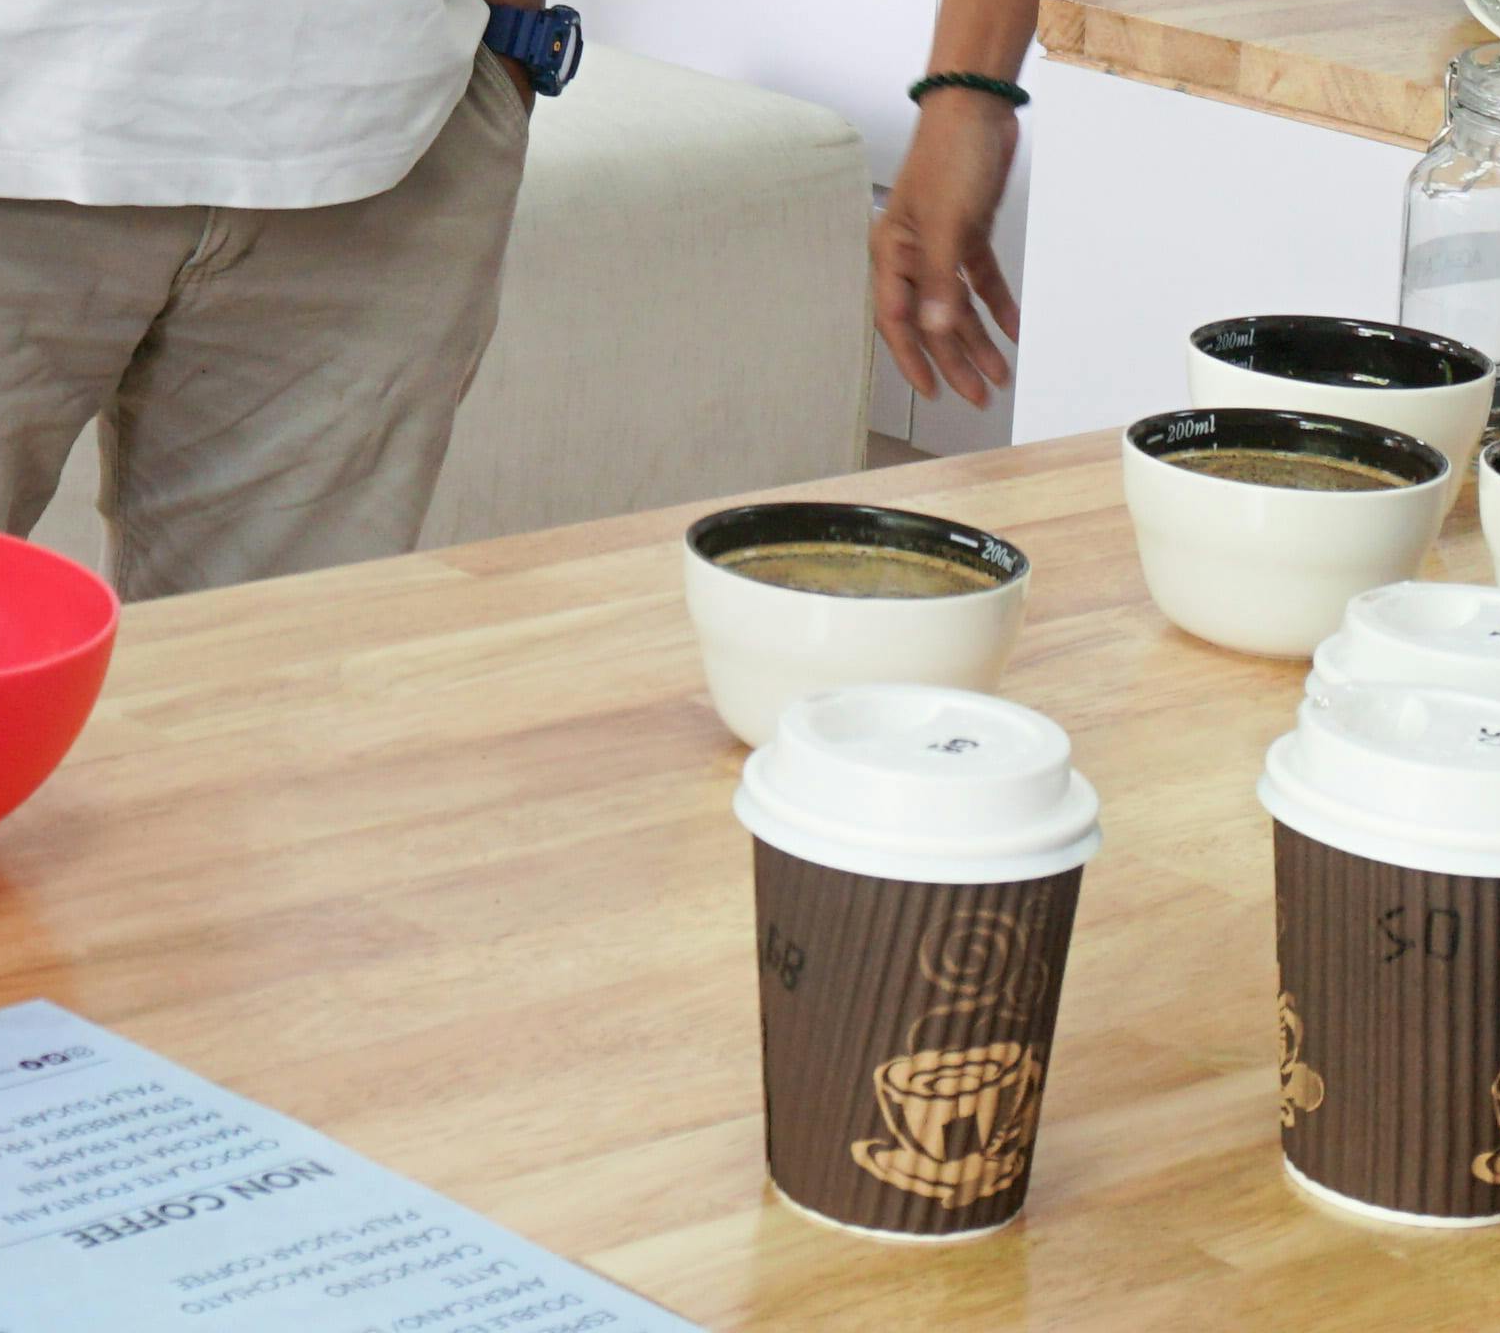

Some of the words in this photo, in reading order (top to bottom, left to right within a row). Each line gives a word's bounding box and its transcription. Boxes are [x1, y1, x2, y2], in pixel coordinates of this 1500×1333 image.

[1167, 414, 1216, 444] 200ml
[94, 1082, 165, 1108] PALM
[14, 1100, 100, 1131] SUGAR
[38, 1097, 194, 1147] STRAWBERRY
[117, 1111, 222, 1145] MATCHA
[24, 1138, 120, 1173] FRAPPE
[148, 1123, 252, 1160] MATCHA
[16, 1155, 147, 1199] FOUNTAIN
[132, 1138, 280, 1187] CHOCOLATE
[225, 1160, 336, 1201] NON
[0, 1183, 135, 1227] FOUNTAIN
[61, 1193, 226, 1250] COFFEE
[352, 1209, 422, 1238] PALM
[267, 1231, 354, 1262] SUGAR
[334, 1226, 451, 1265] CARAMEL
[169, 1256, 266, 1293] COFFEE
[179, 1263, 338, 1316] MACCHIATO
[323, 1244, 483, 1299] CAPPUCCINO
[440, 1260, 518, 1289] LATTE
